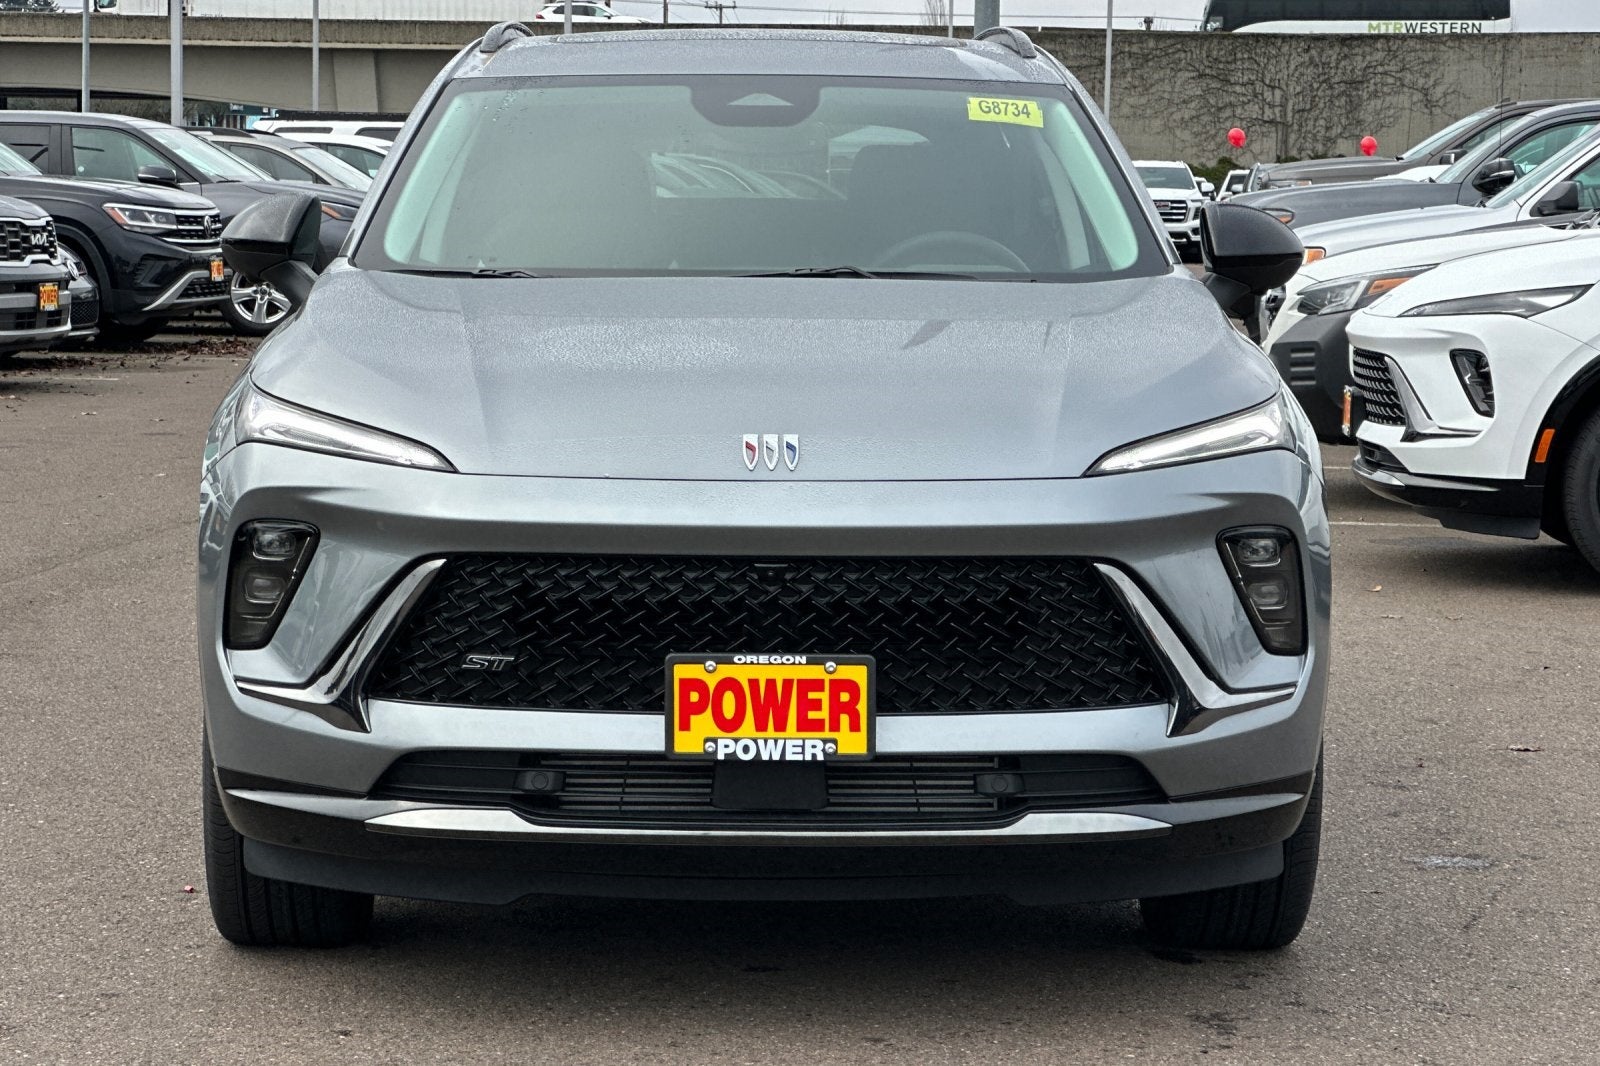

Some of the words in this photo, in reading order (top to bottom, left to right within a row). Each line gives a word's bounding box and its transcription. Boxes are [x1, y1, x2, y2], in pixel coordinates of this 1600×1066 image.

[978, 100, 1031, 118] G8734
[461, 655, 515, 670] ST
[733, 655, 807, 664] OREGON
[678, 676, 861, 733] POWER
[716, 738, 825, 760] POWER
